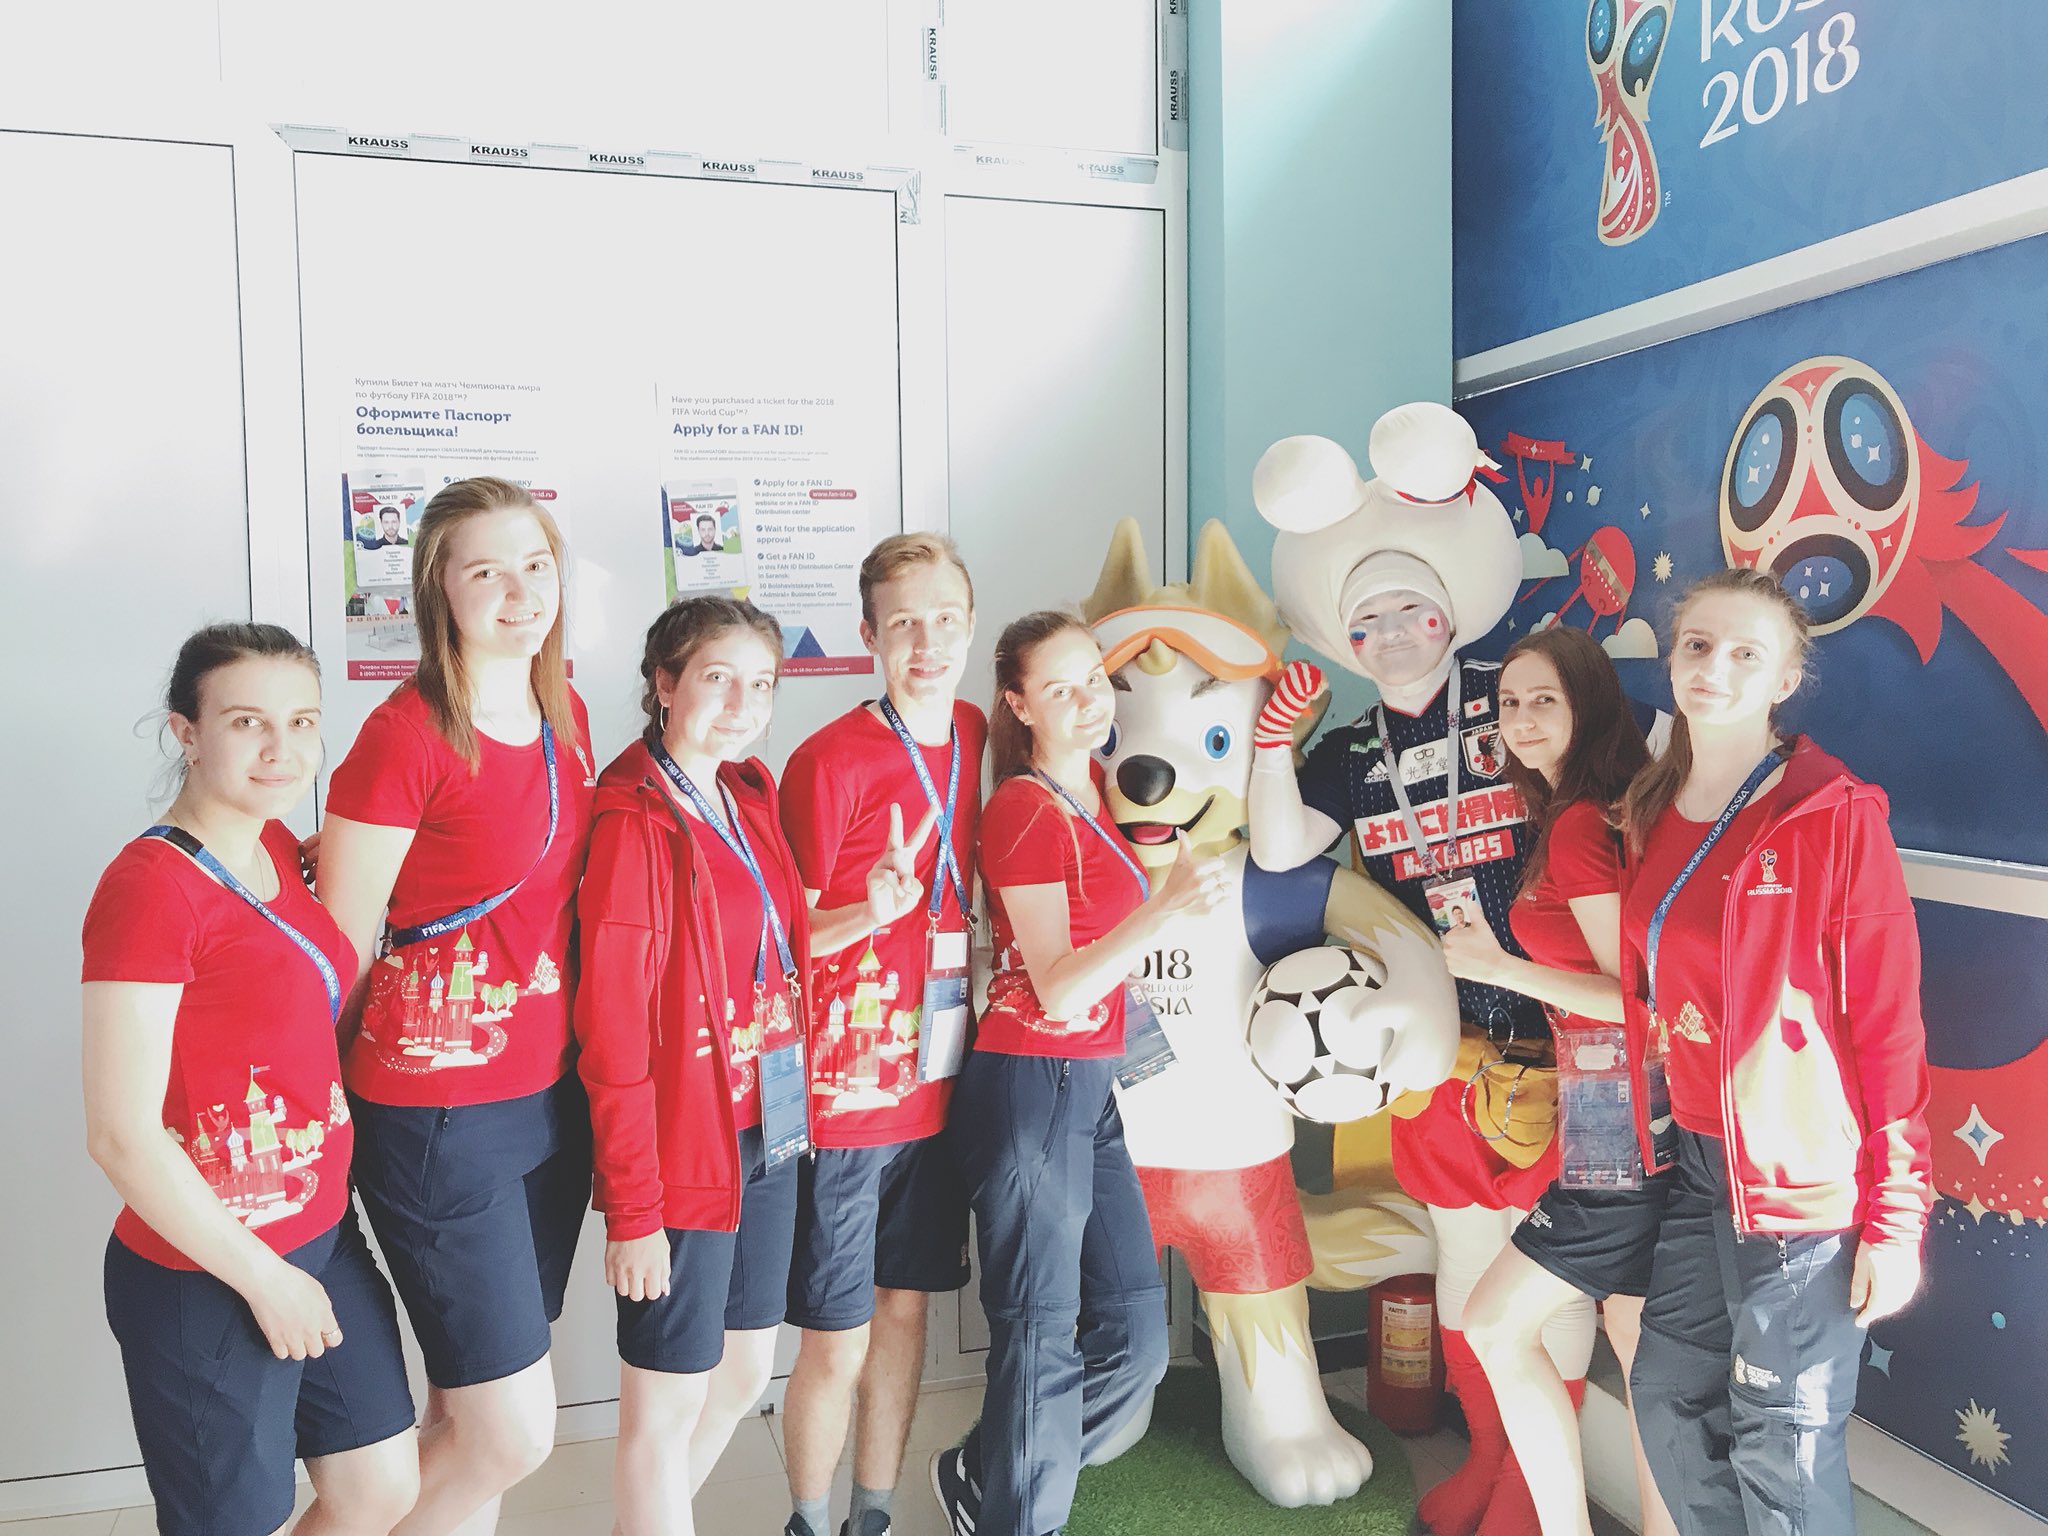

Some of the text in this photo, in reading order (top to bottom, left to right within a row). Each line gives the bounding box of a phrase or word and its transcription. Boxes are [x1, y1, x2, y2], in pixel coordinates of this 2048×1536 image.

[929, 28, 937, 80] KRAUSS
[1699, 12, 1860, 149] 2018
[1170, 70, 1178, 121] KRAUSS
[348, 136, 409, 149] KRAUSS
[471, 145, 528, 158] KRAUSS
[589, 153, 645, 165] KRAUSS
[702, 161, 756, 173] KRAUSS
[812, 169, 864, 181] KRAUSS
[355, 377, 389, 388] Купили
[392, 378, 418, 387] Билет
[459, 381, 515, 390] Чемпионата
[518, 384, 541, 392] мира
[369, 390, 408, 401] футболу
[411, 391, 430, 400] FIFA
[671, 395, 692, 404] Have
[694, 397, 710, 406] you
[712, 396, 754, 406] purchased
[763, 396, 785, 405] ticket
[787, 397, 799, 405] for
[800, 397, 814, 405] the
[815, 398, 834, 406] 2018
[356, 405, 511, 424] Оформите Паспорт
[672, 407, 690, 416] FIFA
[692, 407, 717, 416] World
[356, 422, 458, 437] болельщика!
[672, 423, 803, 437] Apply for a FAN ID!
[762, 479, 785, 488] Apply
[786, 479, 798, 487] for
[806, 479, 822, 487] FAN
[824, 479, 832, 487] ID
[783, 524, 795, 532] for
[812, 524, 855, 534] application
[756, 536, 791, 544] approval
[766, 552, 780, 560] Get
[789, 552, 805, 560] FAN
[807, 552, 815, 560] ID
[817, 590, 837, 598] Center
[882, 701, 904, 731] RUSSIA
[1364, 774, 1390, 784] adida
[660, 755, 679, 776] 2018
[675, 772, 694, 793] FIFA
[689, 789, 716, 821] WORLD
[712, 818, 730, 838] CUP
[1657, 890, 1676, 912] 2018
[1671, 871, 1689, 892] FIFA
[1684, 839, 1711, 872] WORLD
[1707, 820, 1724, 842] CUP
[1747, 886, 1793, 896] RUSSIA 2018
[421, 915, 466, 937] FIFA.com
[235, 883, 339, 998] 2018 FIFA WORLD CUP RUSSIA
[1170, 983, 1193, 993] CUP
[1150, 996, 1193, 1015] SIA
